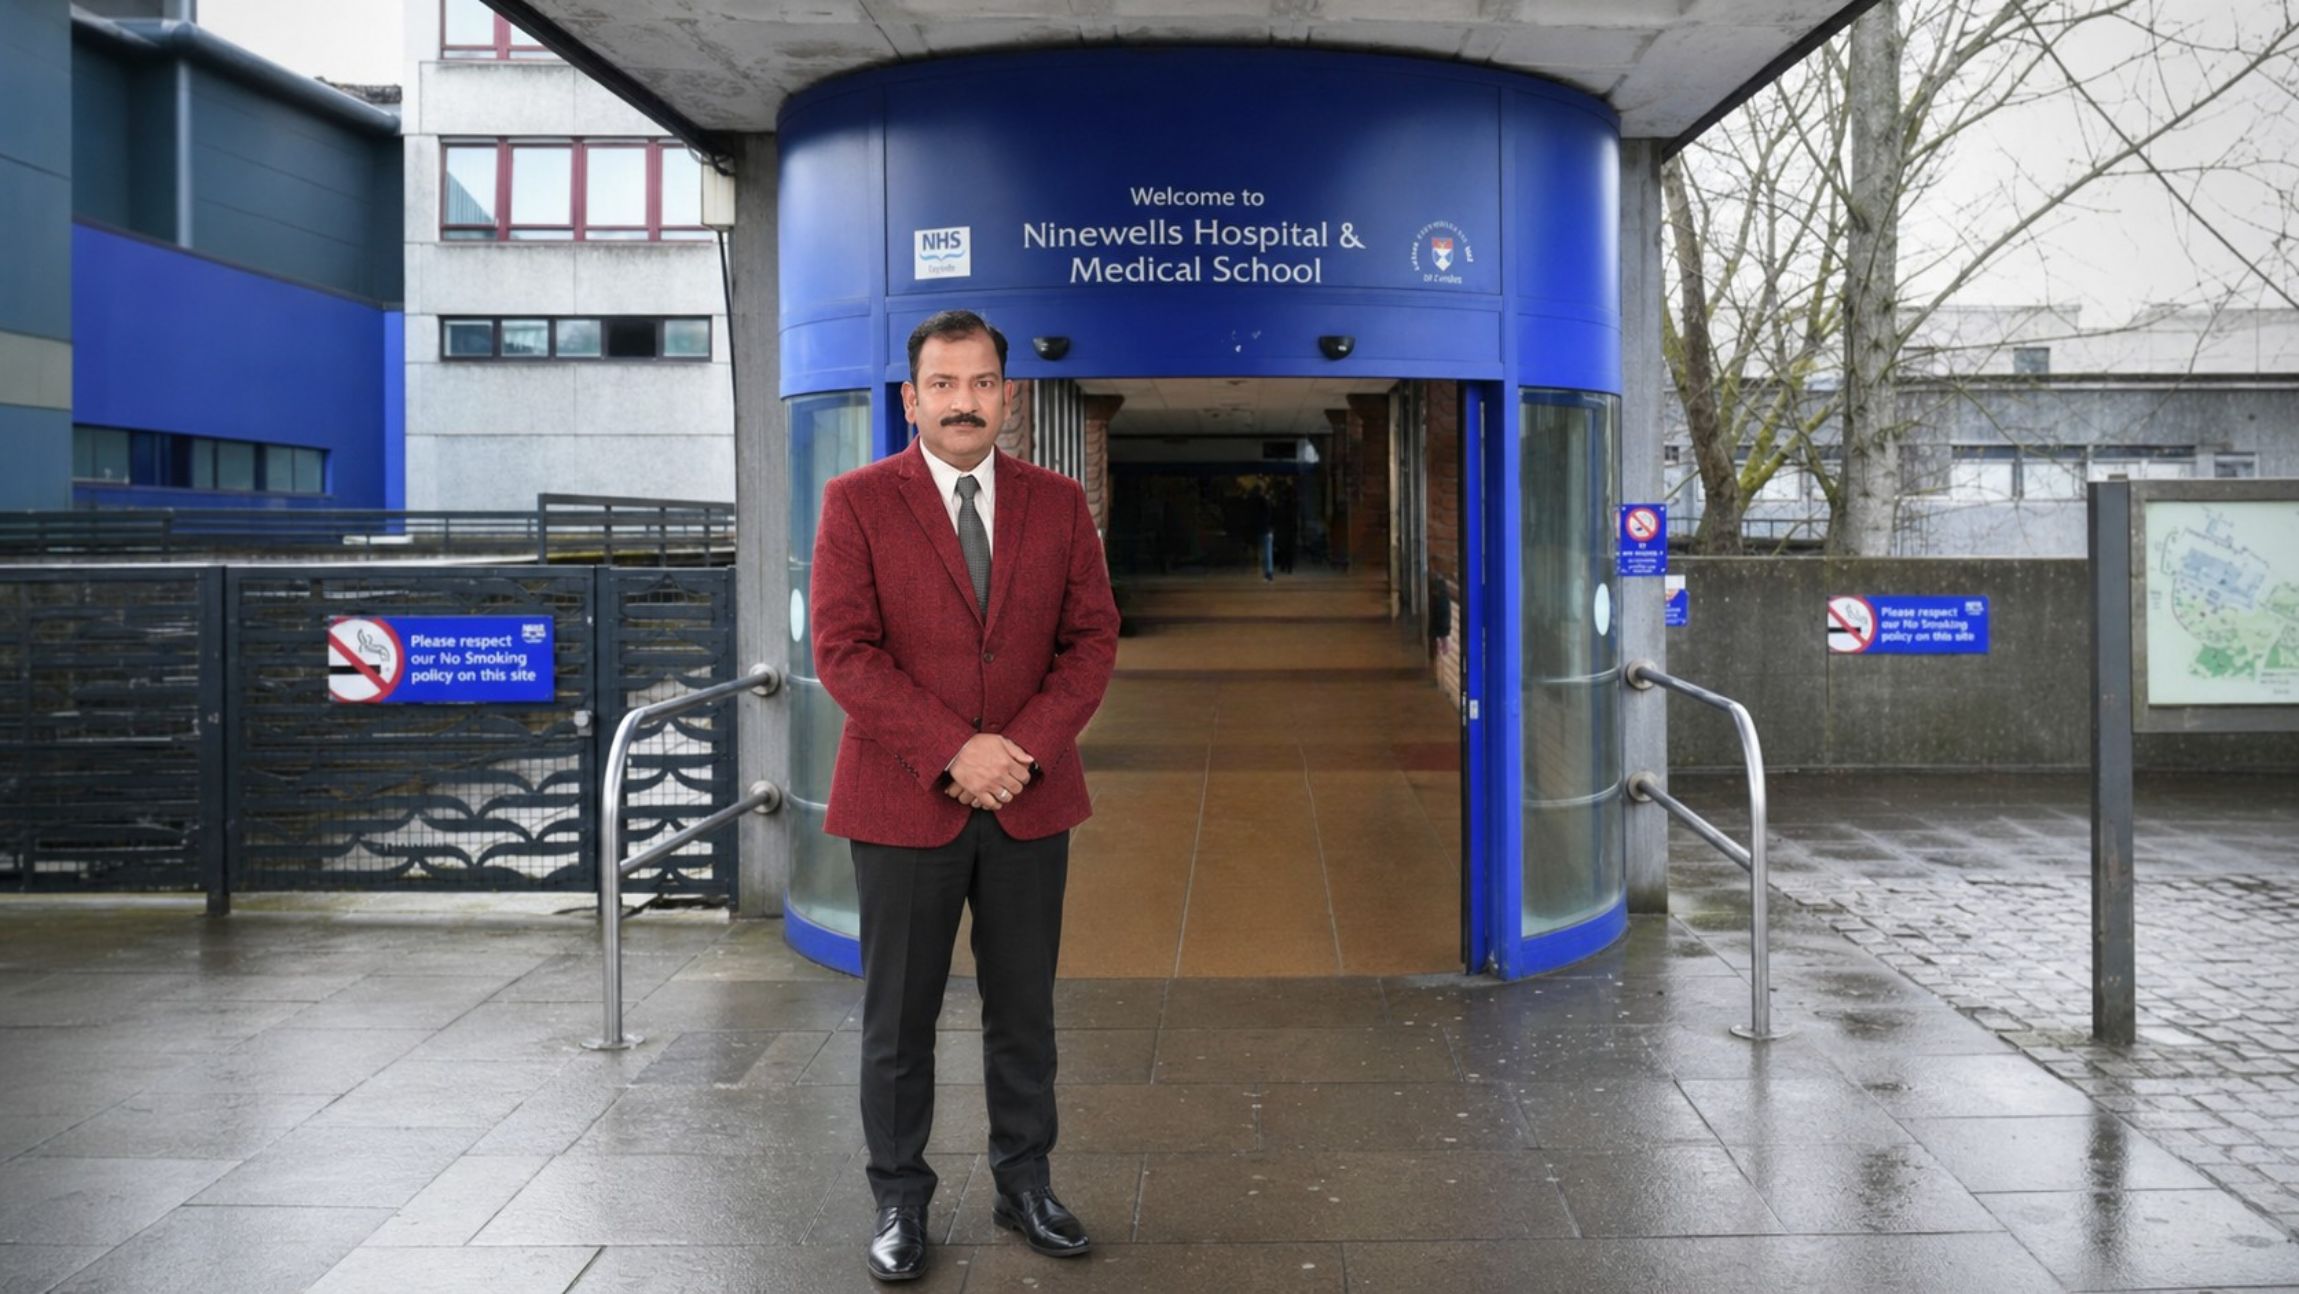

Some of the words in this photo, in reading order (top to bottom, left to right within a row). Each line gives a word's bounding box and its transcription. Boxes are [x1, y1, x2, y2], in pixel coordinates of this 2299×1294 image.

[1130, 187, 1235, 207] Welcome
[1242, 190, 1265, 207] to
[922, 231, 961, 251] NHS
[1023, 219, 1184, 249] Ninewells
[1194, 219, 1328, 252] Hospital
[1339, 222, 1365, 249] &
[1070, 256, 1201, 284] Medical
[1212, 256, 1321, 284] School
[1881, 607, 1915, 617] Please
[1918, 608, 1958, 619] respect
[1903, 620, 1919, 629] No
[411, 634, 456, 647] Please
[460, 635, 512, 650] respect
[1881, 631, 1913, 643] policy
[411, 654, 436, 665] our
[440, 652, 461, 665] No
[465, 651, 527, 667] Smoking
[411, 668, 453, 685] policy
[457, 671, 476, 681] on
[480, 668, 506, 681] this
[510, 668, 536, 681] site
